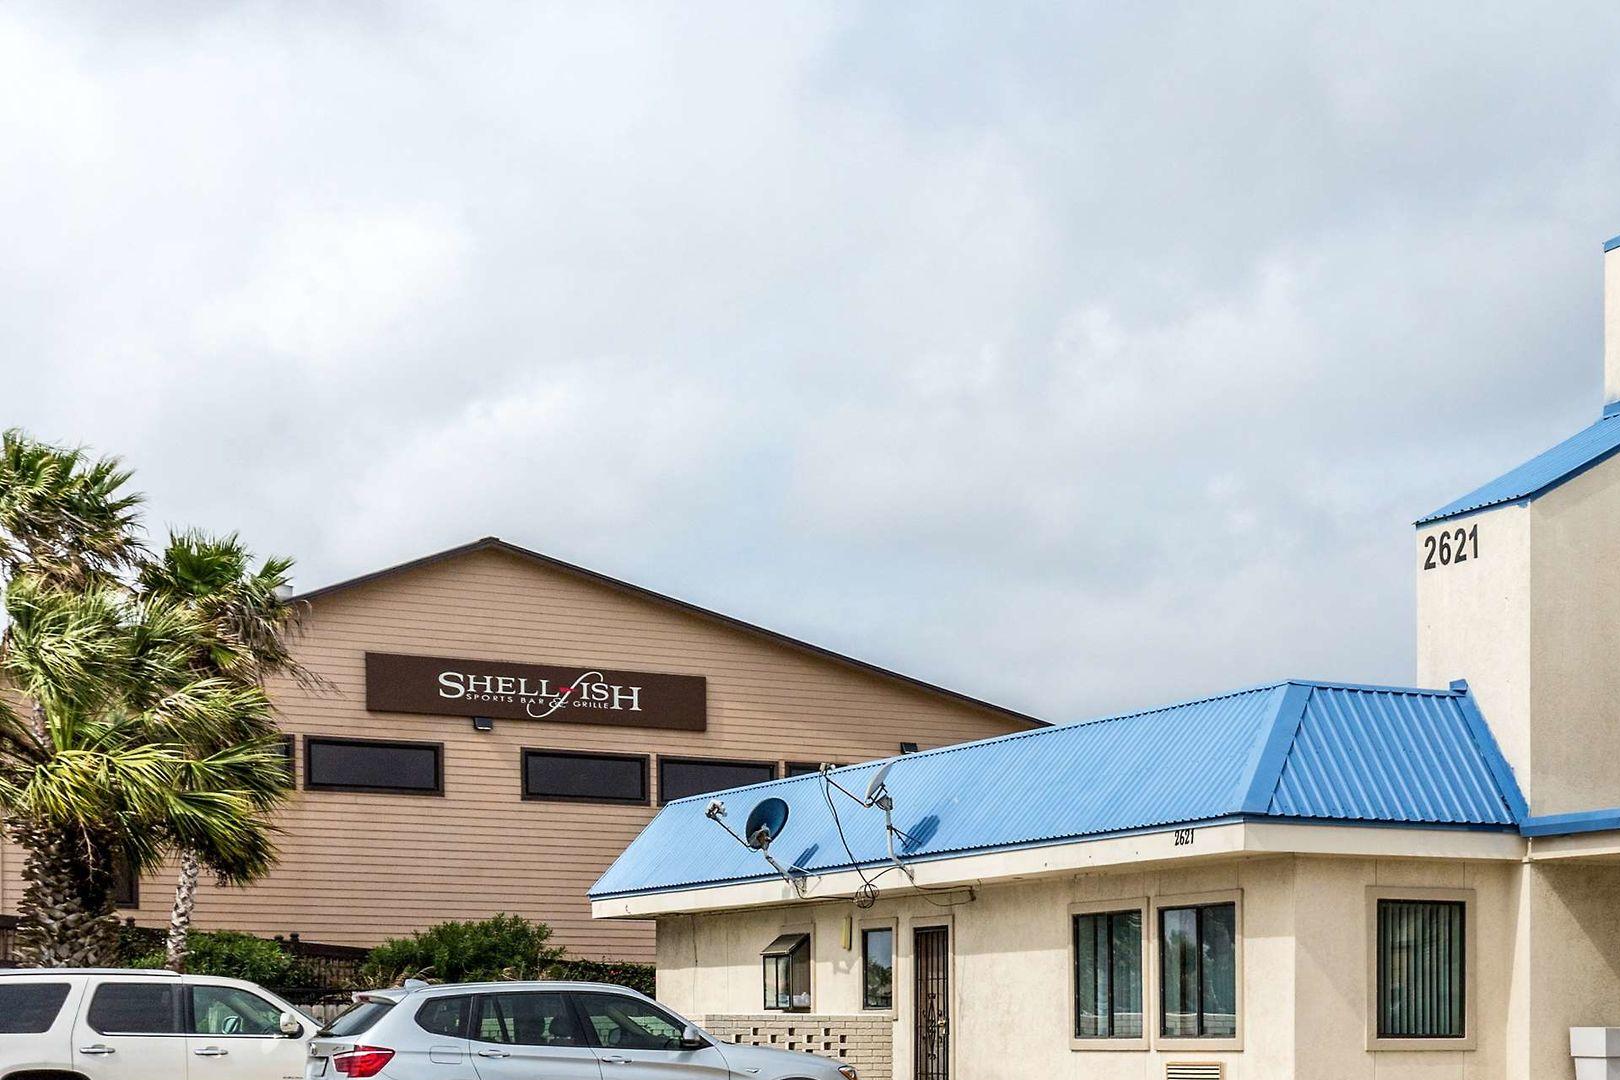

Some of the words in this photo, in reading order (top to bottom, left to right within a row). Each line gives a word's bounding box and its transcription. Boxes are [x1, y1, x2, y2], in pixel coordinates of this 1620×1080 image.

[1424, 523, 1478, 570] 2621
[465, 693, 514, 703] SPORTS
[572, 700, 609, 710] GRILLE
[1174, 828, 1195, 847] 2621
